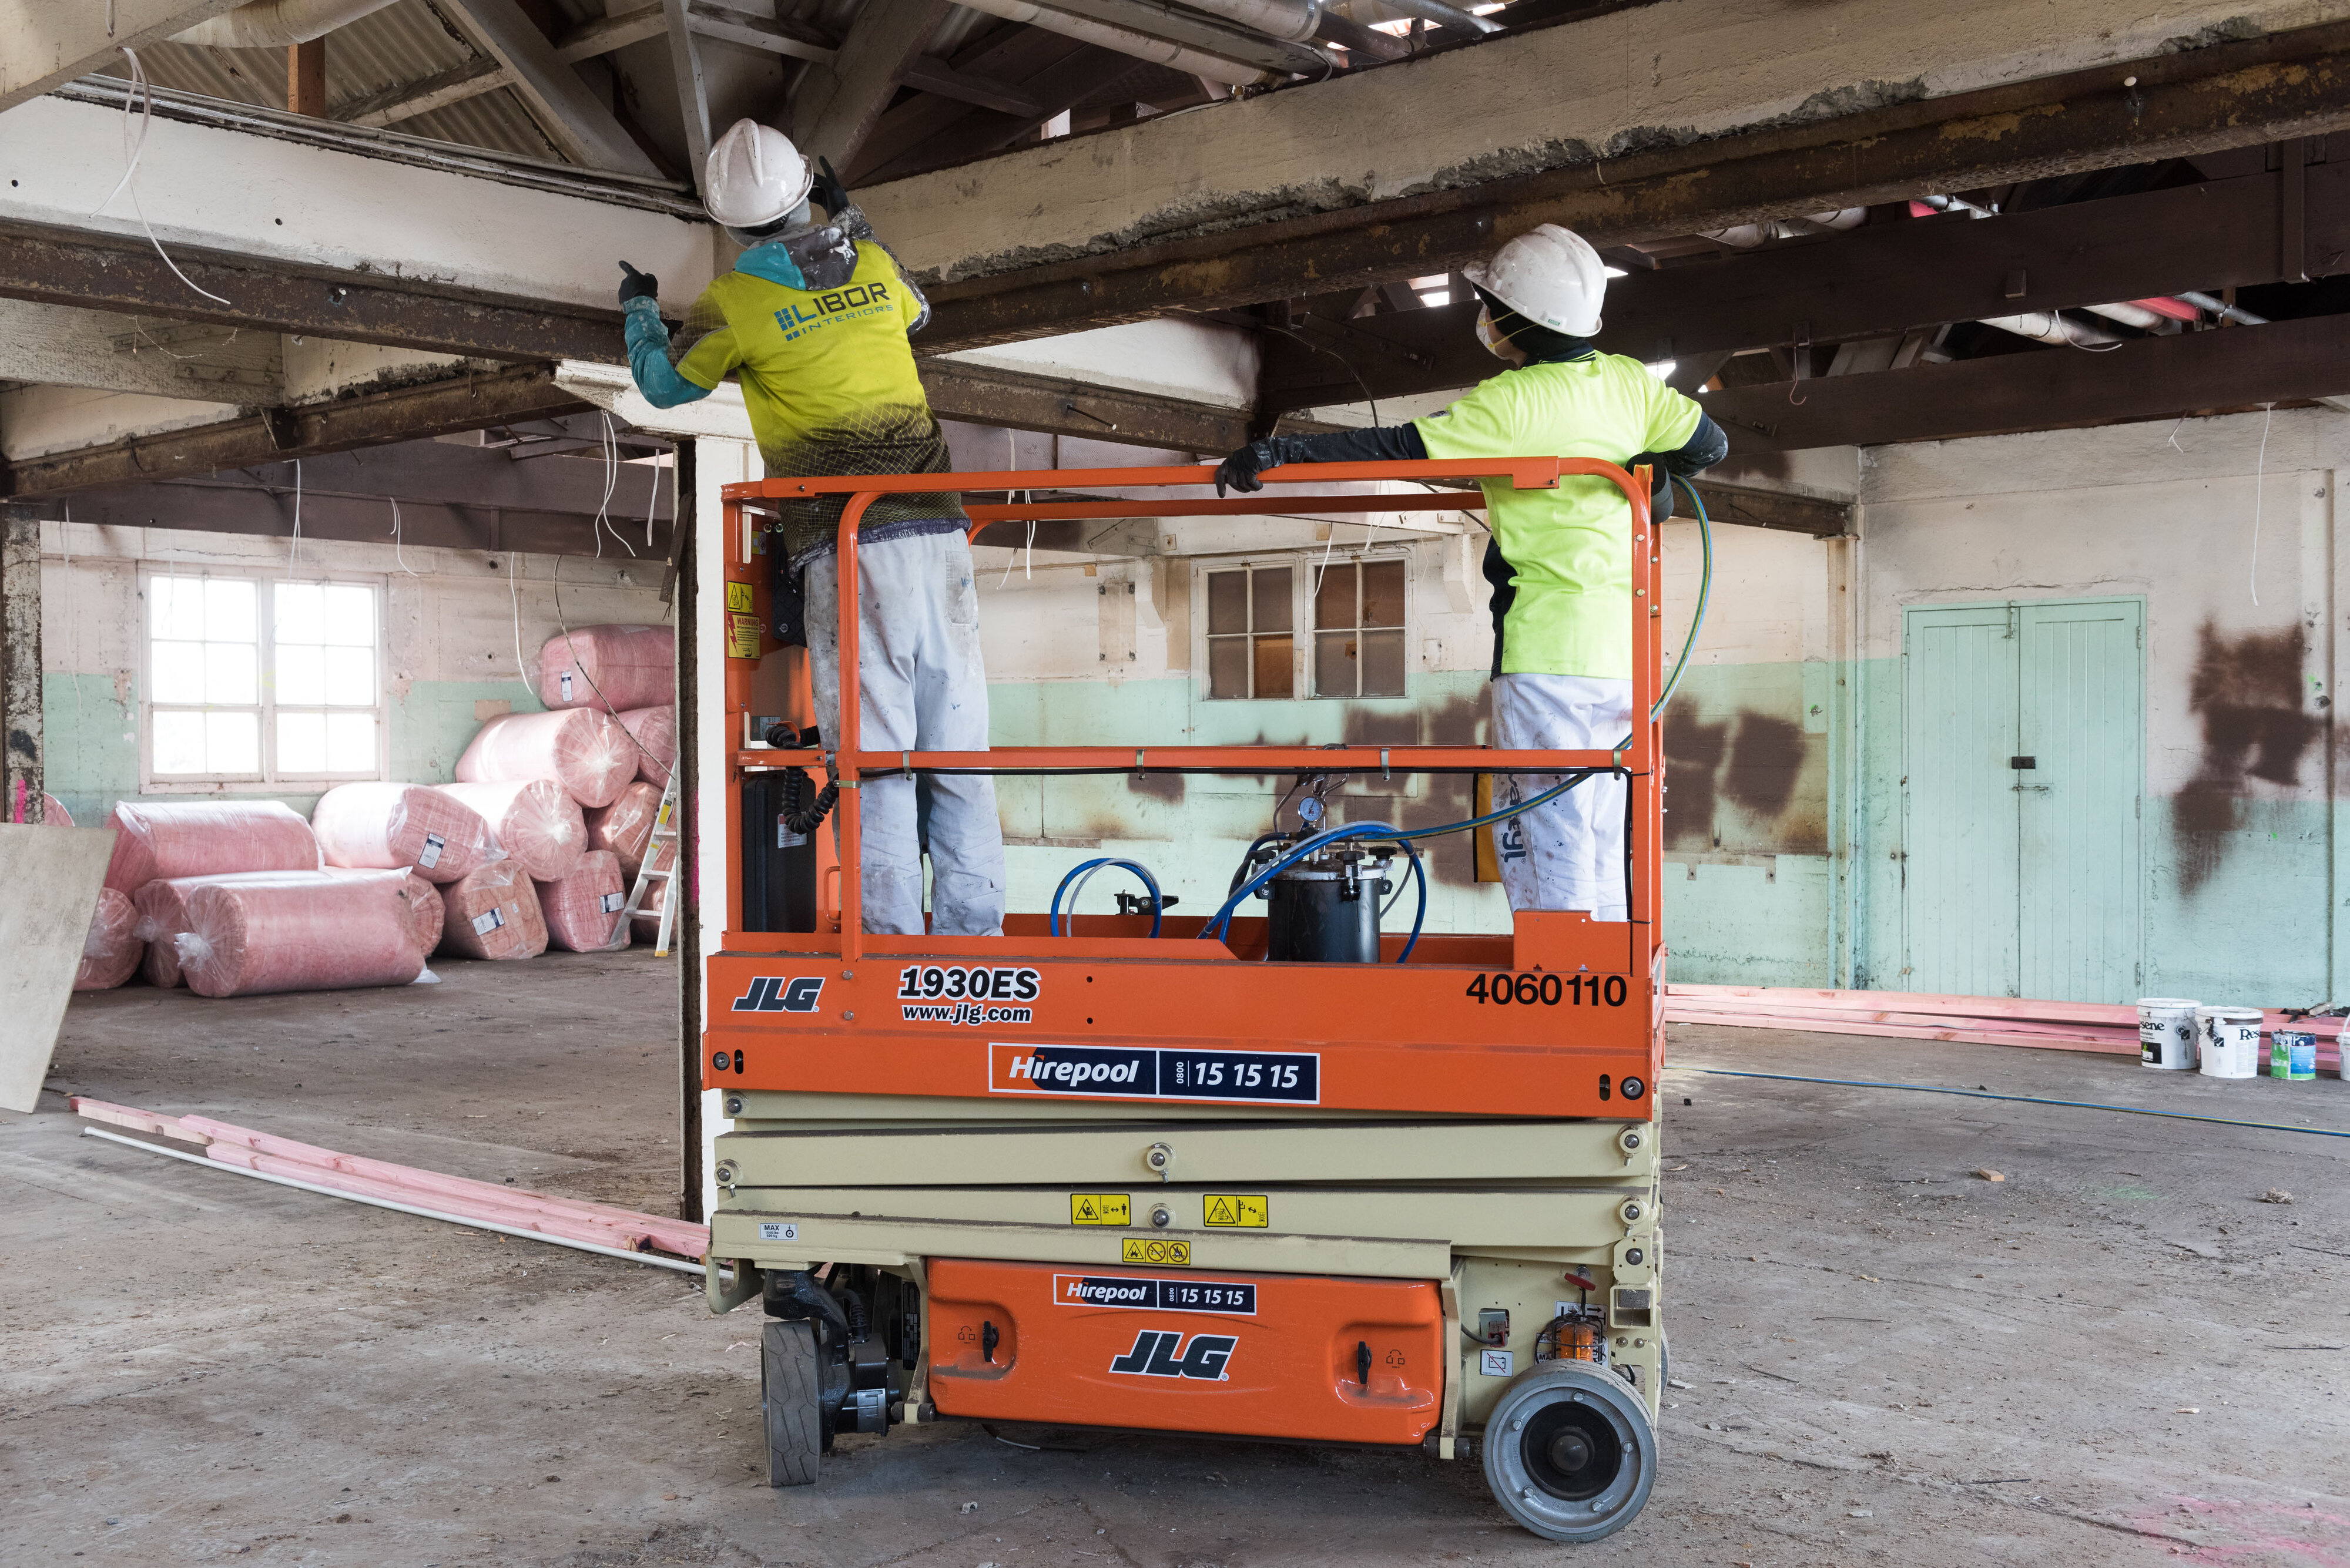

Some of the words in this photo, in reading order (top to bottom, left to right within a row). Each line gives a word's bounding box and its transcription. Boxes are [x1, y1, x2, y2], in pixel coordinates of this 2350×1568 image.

[790, 283, 890, 325] LIBOR
[802, 304, 894, 335] INTERIORS
[737, 617, 759, 626] WARNING
[732, 977, 824, 1011] JLG
[899, 966, 1040, 1000] 1930ES
[1466, 973, 1627, 1007] 4060110
[902, 1003, 1031, 1025] www.jlg.com
[2140, 1020, 2165, 1030] sene
[1009, 1056, 1139, 1087] Hirepool
[1176, 1062, 1184, 1084] 0800
[1195, 1062, 1224, 1086] 15
[1233, 1063, 1263, 1087] 15
[1270, 1065, 1299, 1089] 15
[1067, 1282, 1147, 1302] Hirepool
[1181, 1288, 1199, 1303] 15
[1204, 1289, 1222, 1304] 15
[1226, 1291, 1244, 1305] 15
[1109, 1330, 1239, 1381] JLG
